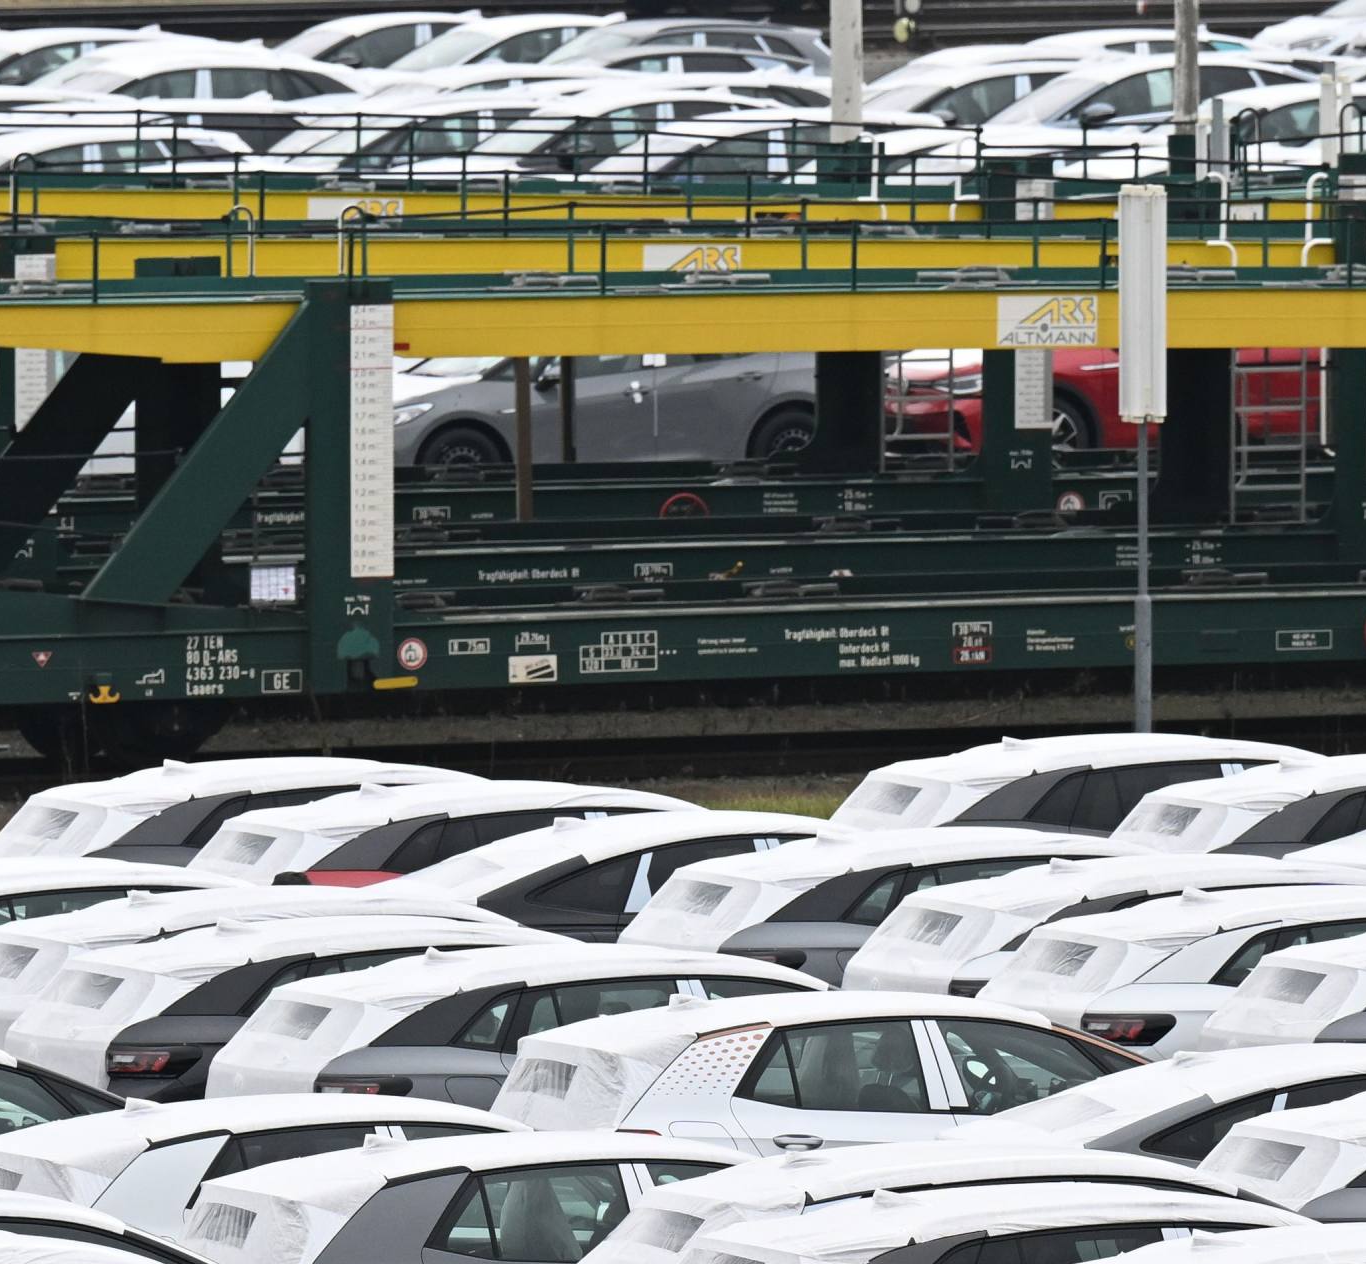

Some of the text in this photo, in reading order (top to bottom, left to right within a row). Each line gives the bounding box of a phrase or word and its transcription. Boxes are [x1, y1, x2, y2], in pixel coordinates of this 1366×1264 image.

[667, 246, 739, 272] ARS
[1018, 297, 1096, 324] ARS
[998, 331, 1096, 345] ALTMANN
[186, 635, 223, 650] 27 TEN
[186, 666, 214, 680] 4363
[186, 682, 224, 696] Laaers
[273, 673, 291, 690] GE
